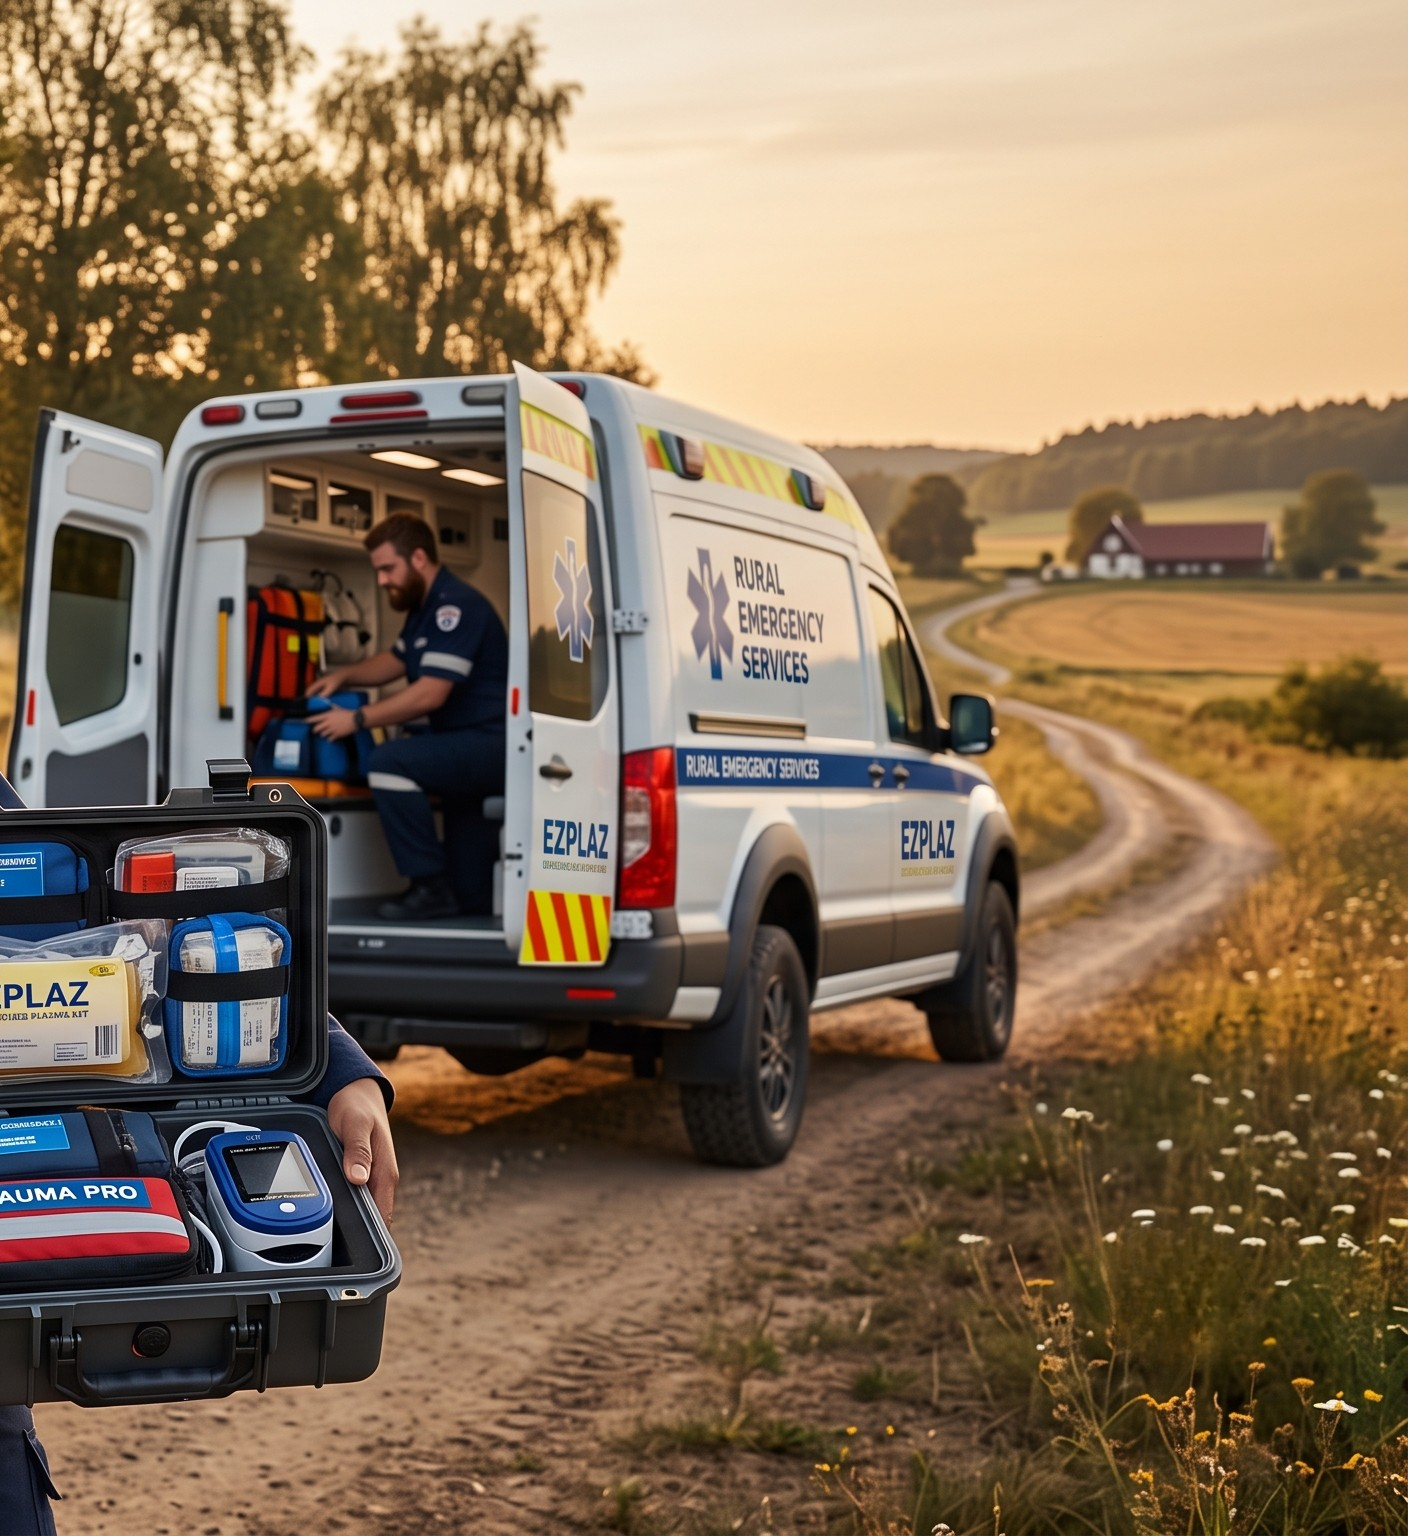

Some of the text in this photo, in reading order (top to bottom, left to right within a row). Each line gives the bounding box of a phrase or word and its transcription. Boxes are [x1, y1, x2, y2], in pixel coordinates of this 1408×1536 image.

[733, 555, 785, 596] RURAL
[737, 600, 824, 644] EMERGENCY
[741, 644, 809, 685] SERVICES
[685, 754, 720, 778] RURAL
[721, 755, 778, 779] EMERGENCY
[543, 818, 609, 860] EZPLAZ
[901, 820, 955, 860] EZPLAZ
[83, 1185, 138, 1200] PRO
